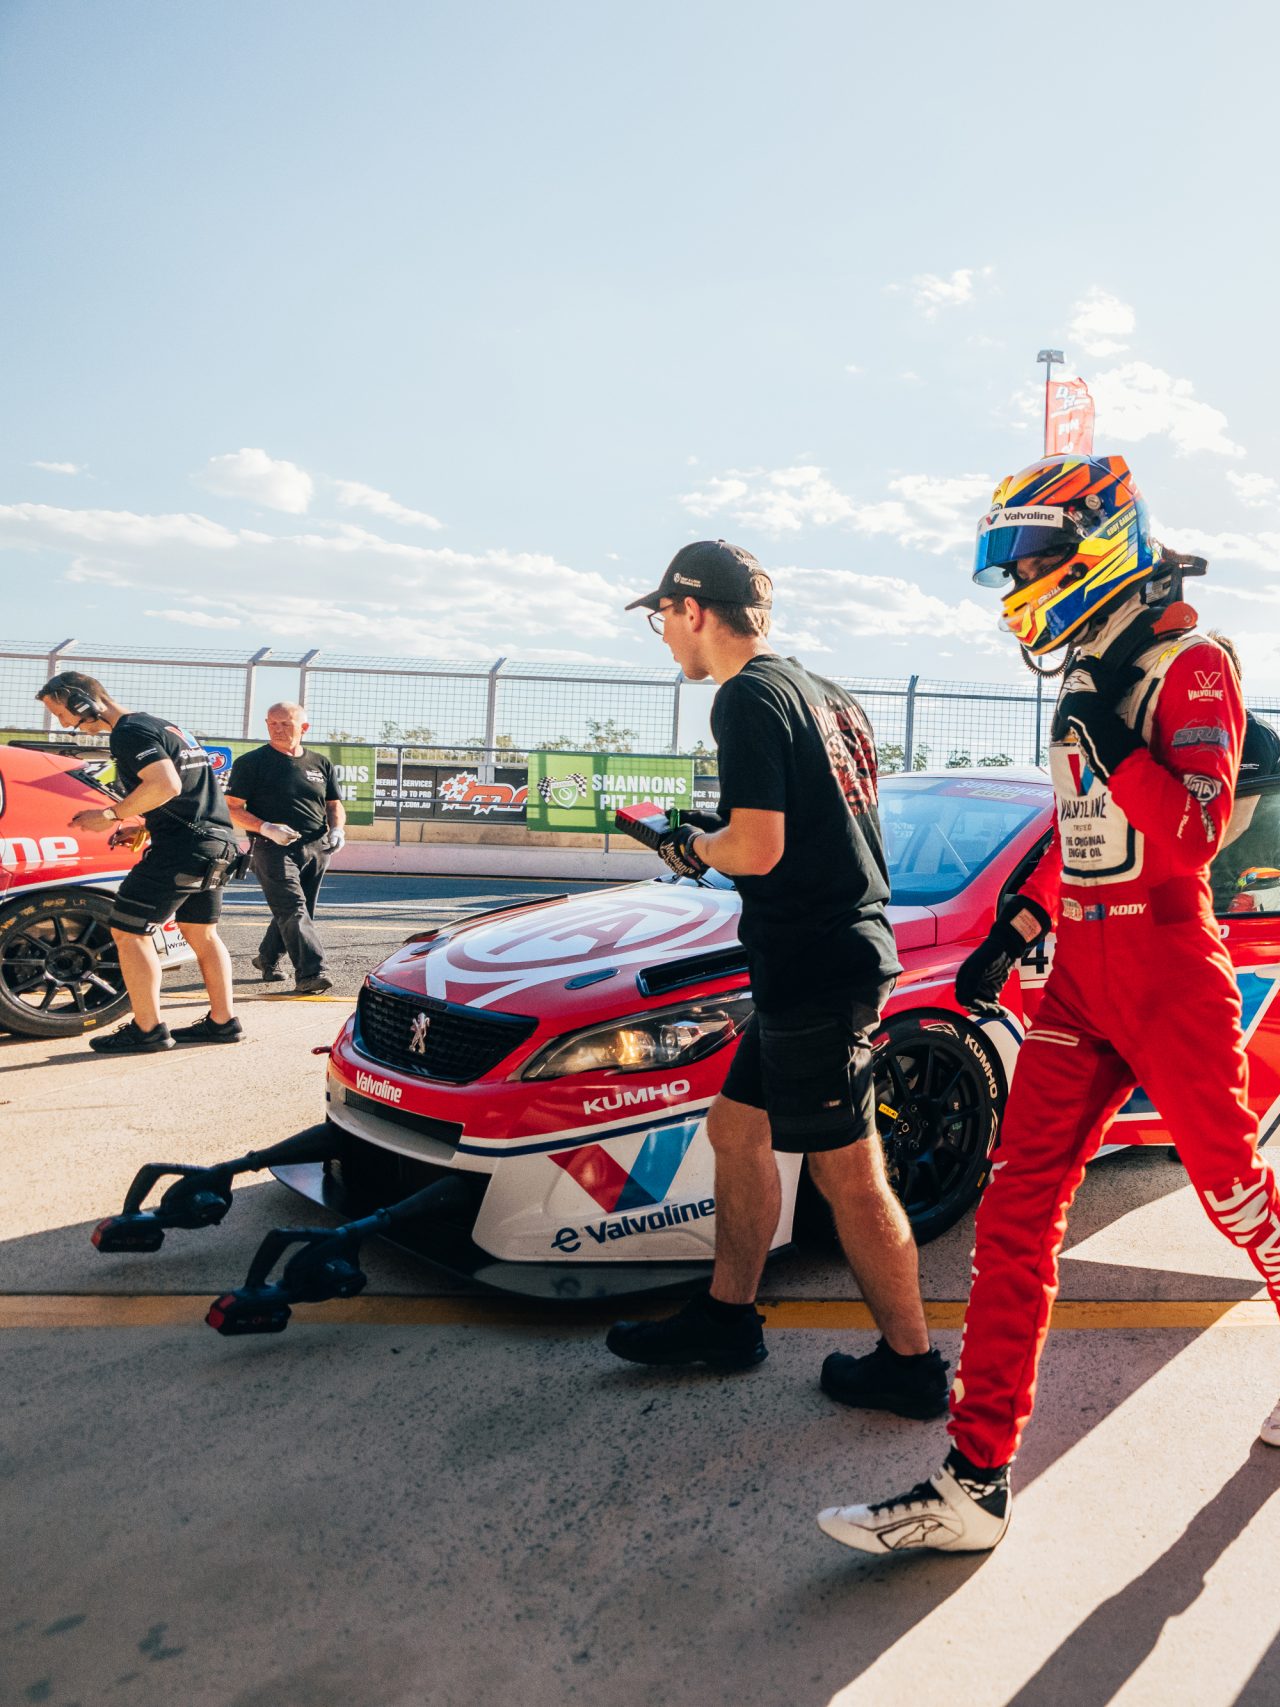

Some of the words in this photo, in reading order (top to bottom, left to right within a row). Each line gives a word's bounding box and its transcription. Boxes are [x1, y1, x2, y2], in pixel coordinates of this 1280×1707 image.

[1004, 511, 1055, 521] Valvoline
[1188, 689, 1224, 701] VALVOLINE
[402, 780, 433, 788] SERVICES
[592, 774, 687, 795] SHANNONS
[600, 794, 627, 811] PIT
[1109, 903, 1147, 917] KODY
[964, 1033, 999, 1099] KUMHO
[356, 1070, 403, 1104] Valvoline
[582, 1079, 691, 1115] KUMHO
[584, 1198, 717, 1245] Valvoline
